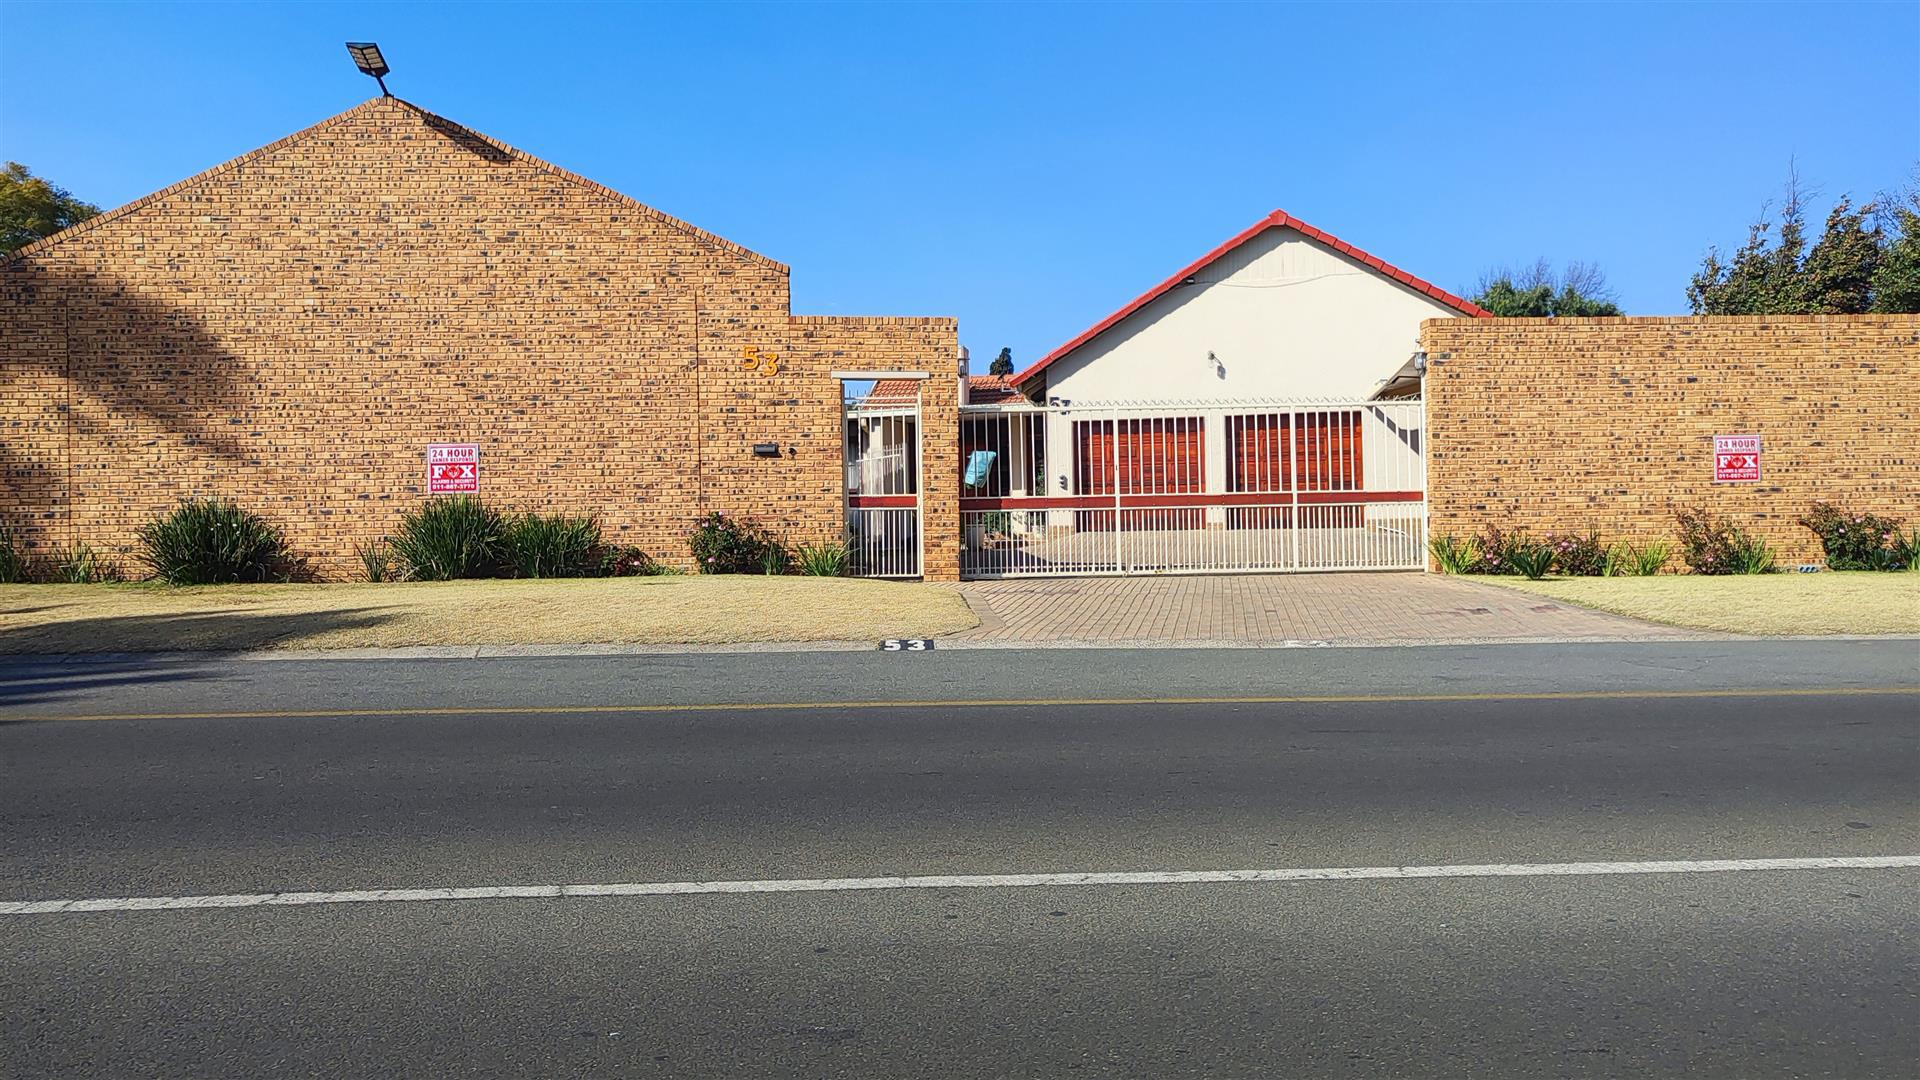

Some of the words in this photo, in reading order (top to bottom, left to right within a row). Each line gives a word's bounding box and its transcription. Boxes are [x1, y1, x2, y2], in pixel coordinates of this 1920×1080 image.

[743, 345, 779, 377] 53
[1718, 440, 1729, 448] 24
[1731, 440, 1756, 448] HOUR
[432, 449, 443, 457] 24
[447, 449, 474, 457] HOUR
[884, 640, 926, 651] 53
